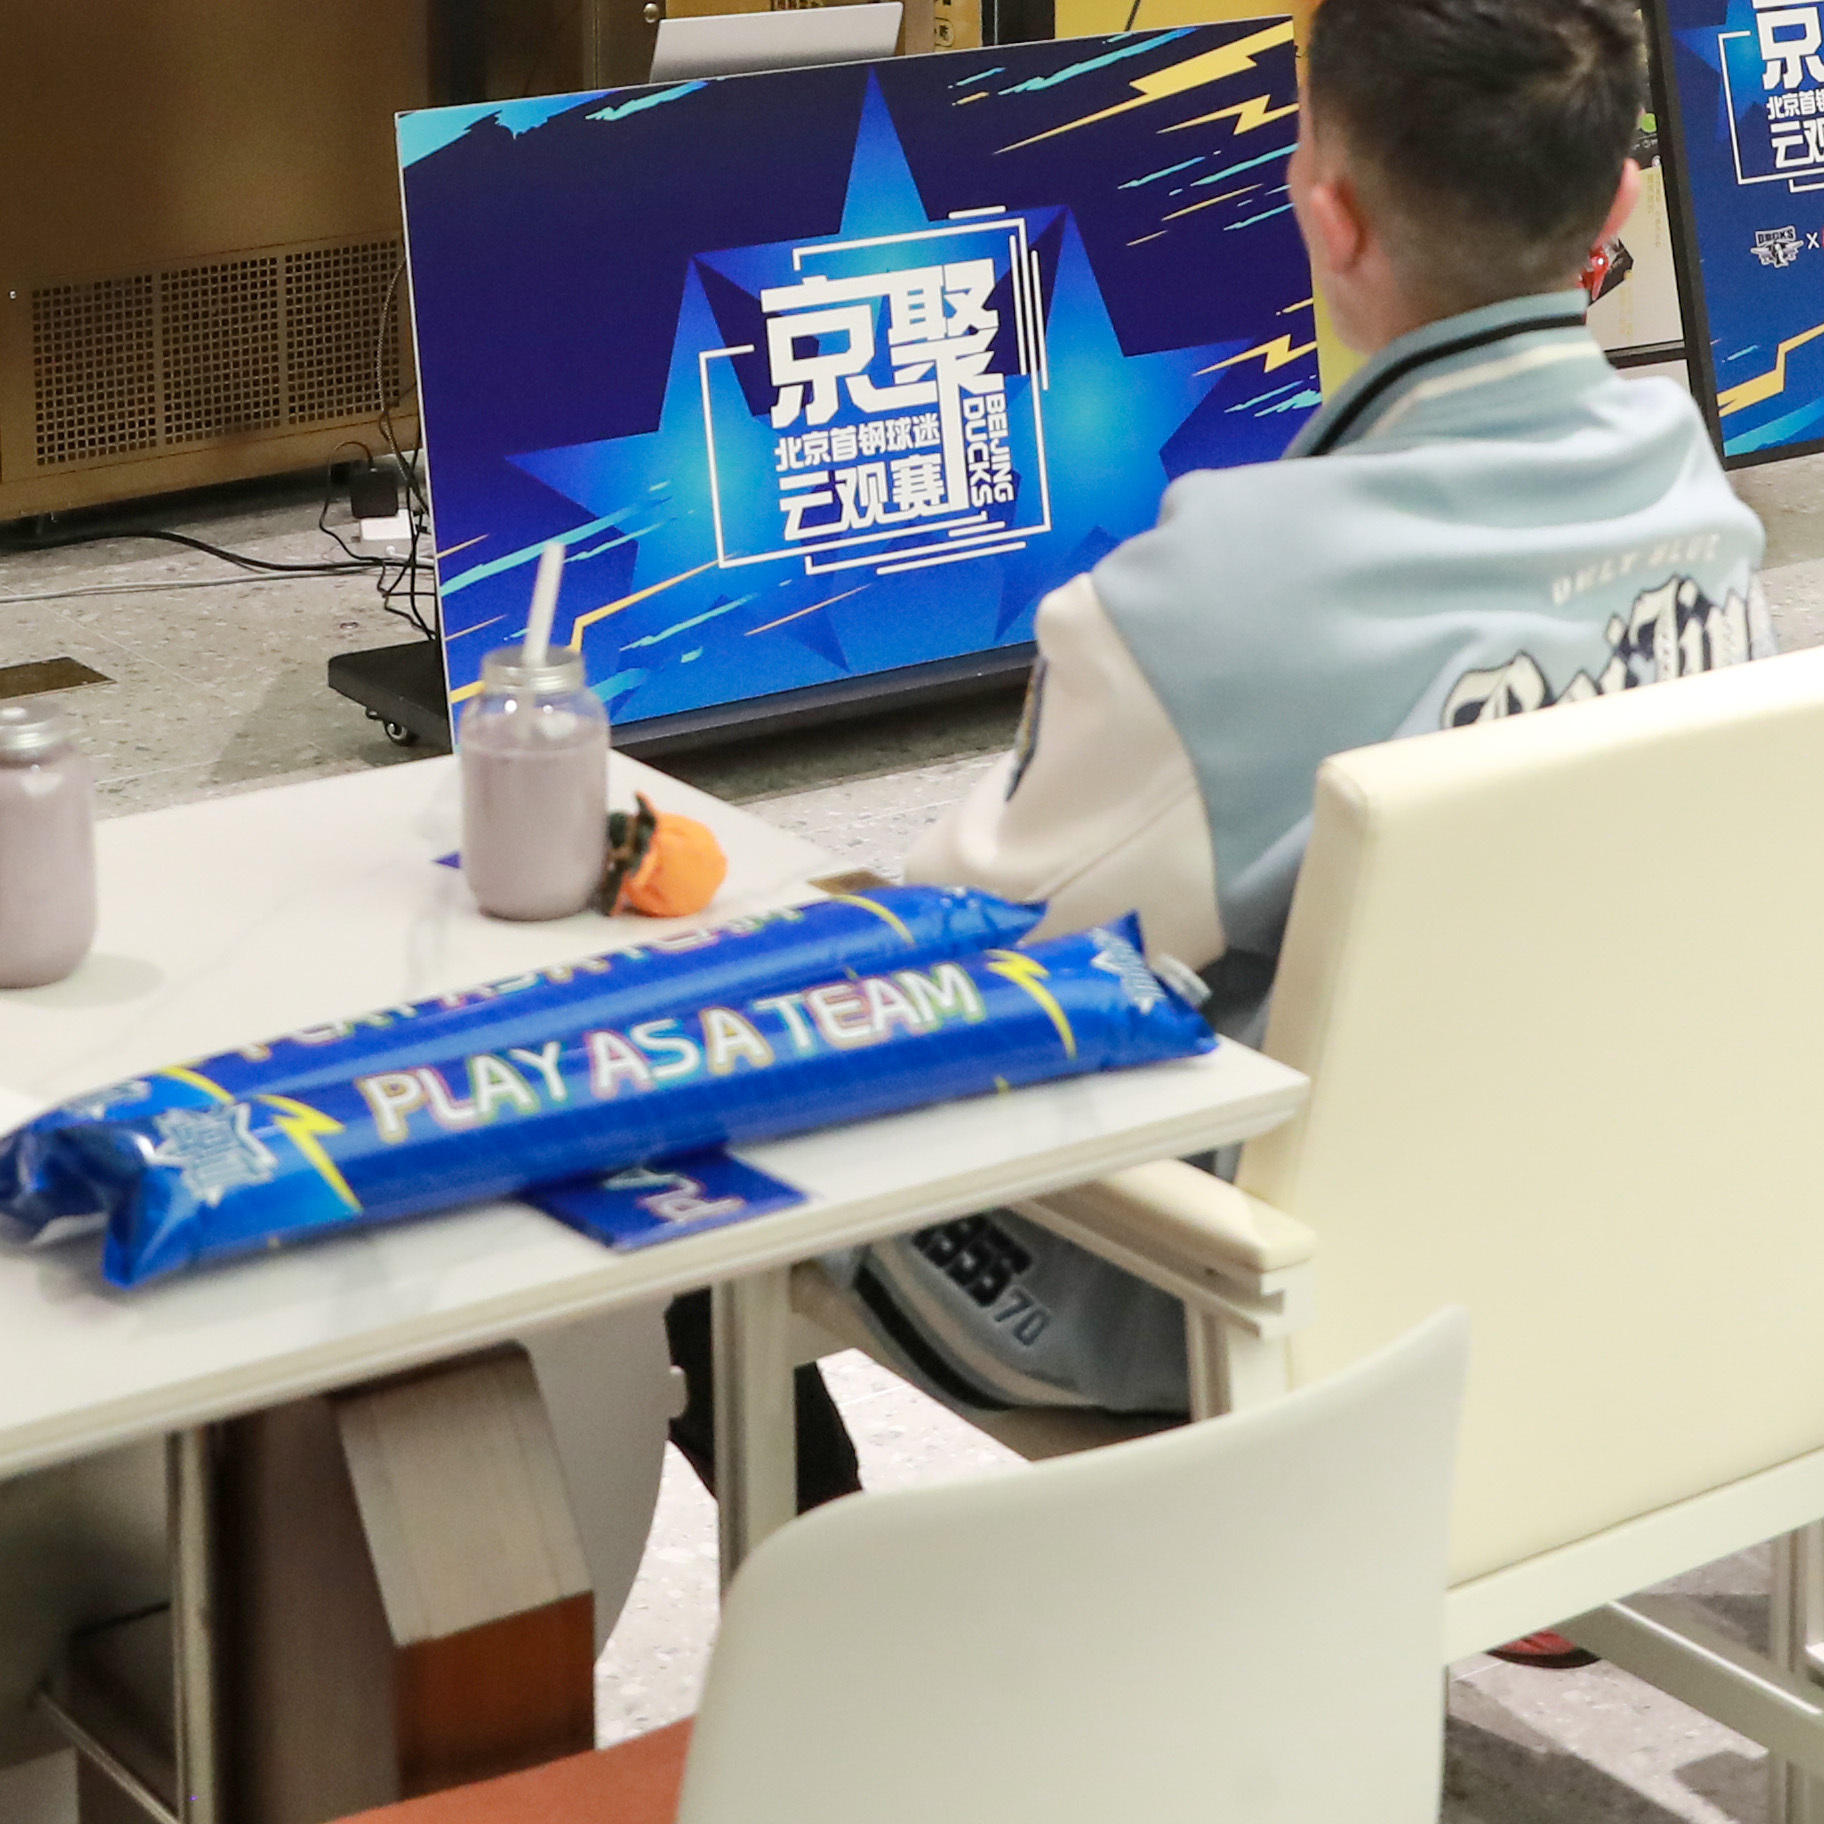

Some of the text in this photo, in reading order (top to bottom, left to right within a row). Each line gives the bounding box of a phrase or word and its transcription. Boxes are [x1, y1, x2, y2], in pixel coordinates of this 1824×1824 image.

[760, 258, 1005, 511] 京聚
[775, 412, 941, 472] 北京首钢球迷
[778, 453, 950, 541] 云观赛
[963, 396, 993, 508] DUCKS
[987, 393, 1014, 503] BEIJING
[358, 960, 988, 1144] PLAY AS A TEAM
